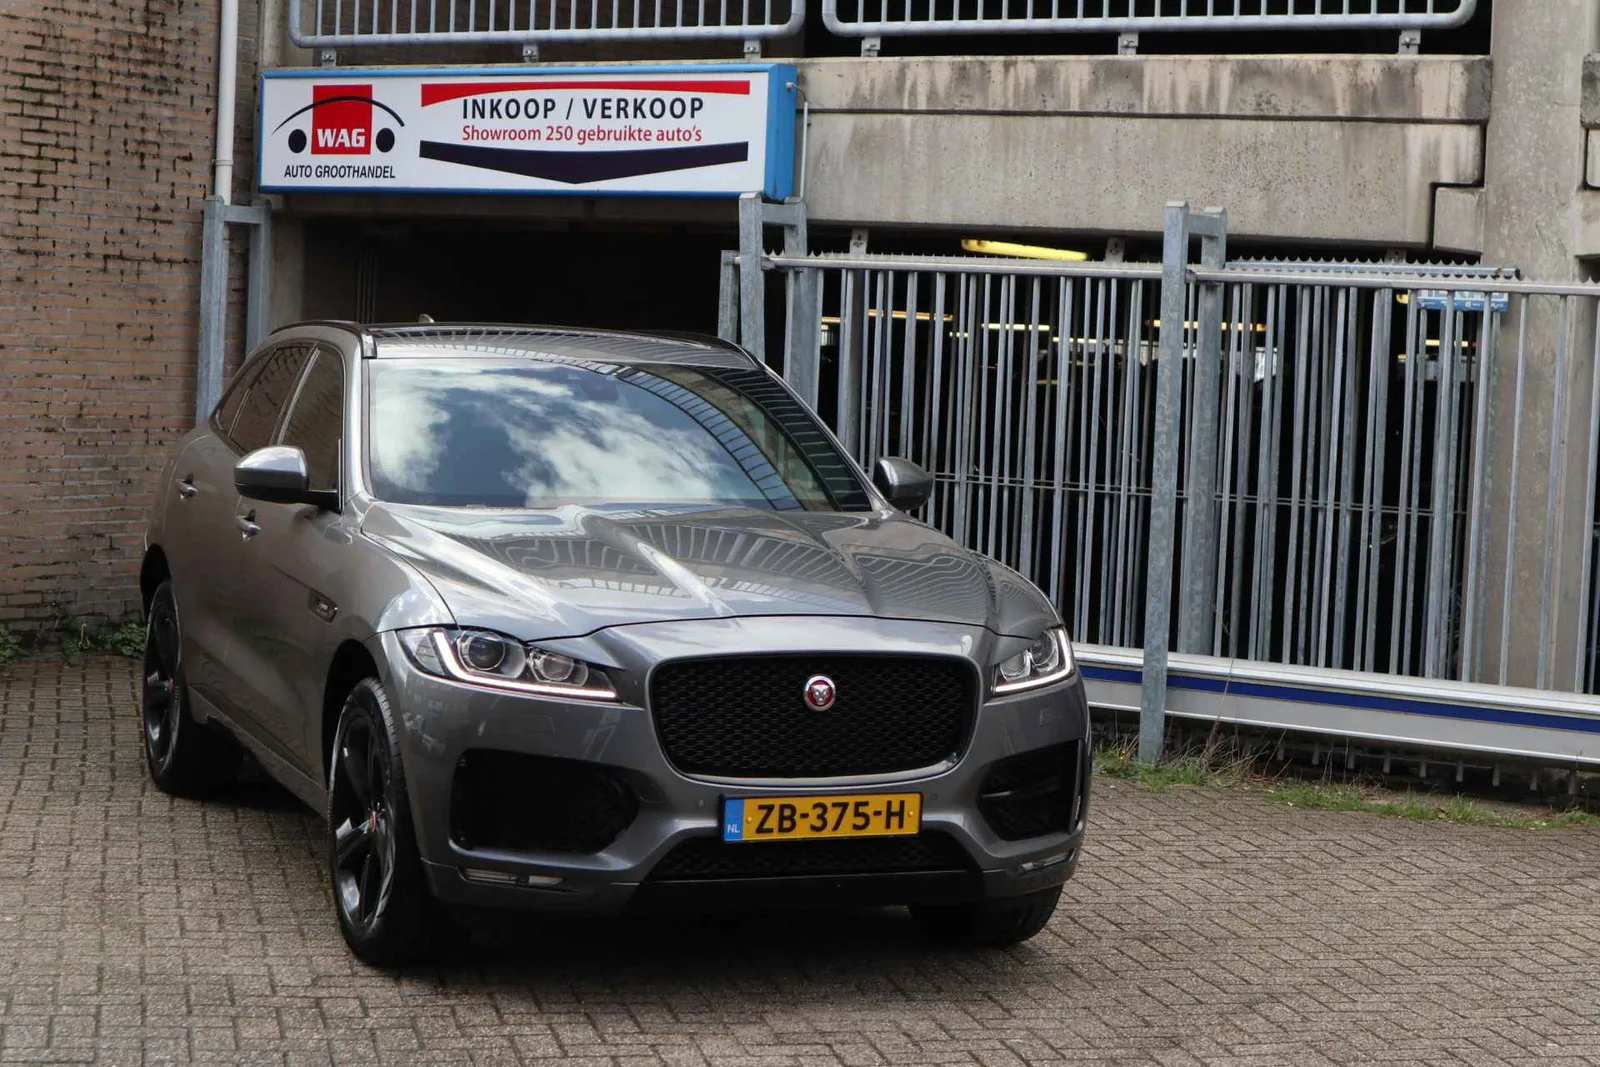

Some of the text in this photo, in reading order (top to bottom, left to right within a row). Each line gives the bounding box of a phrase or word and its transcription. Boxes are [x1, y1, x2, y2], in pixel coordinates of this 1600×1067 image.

[462, 97, 704, 120] INKOOP / VERKOOP
[316, 128, 366, 148] WAG
[462, 124, 702, 145] Showroom 250 gebruikte auto's
[284, 165, 396, 179] AUTO GROOTHANDEL
[755, 800, 905, 834] ZB-375-H
[727, 823, 740, 834] NL
